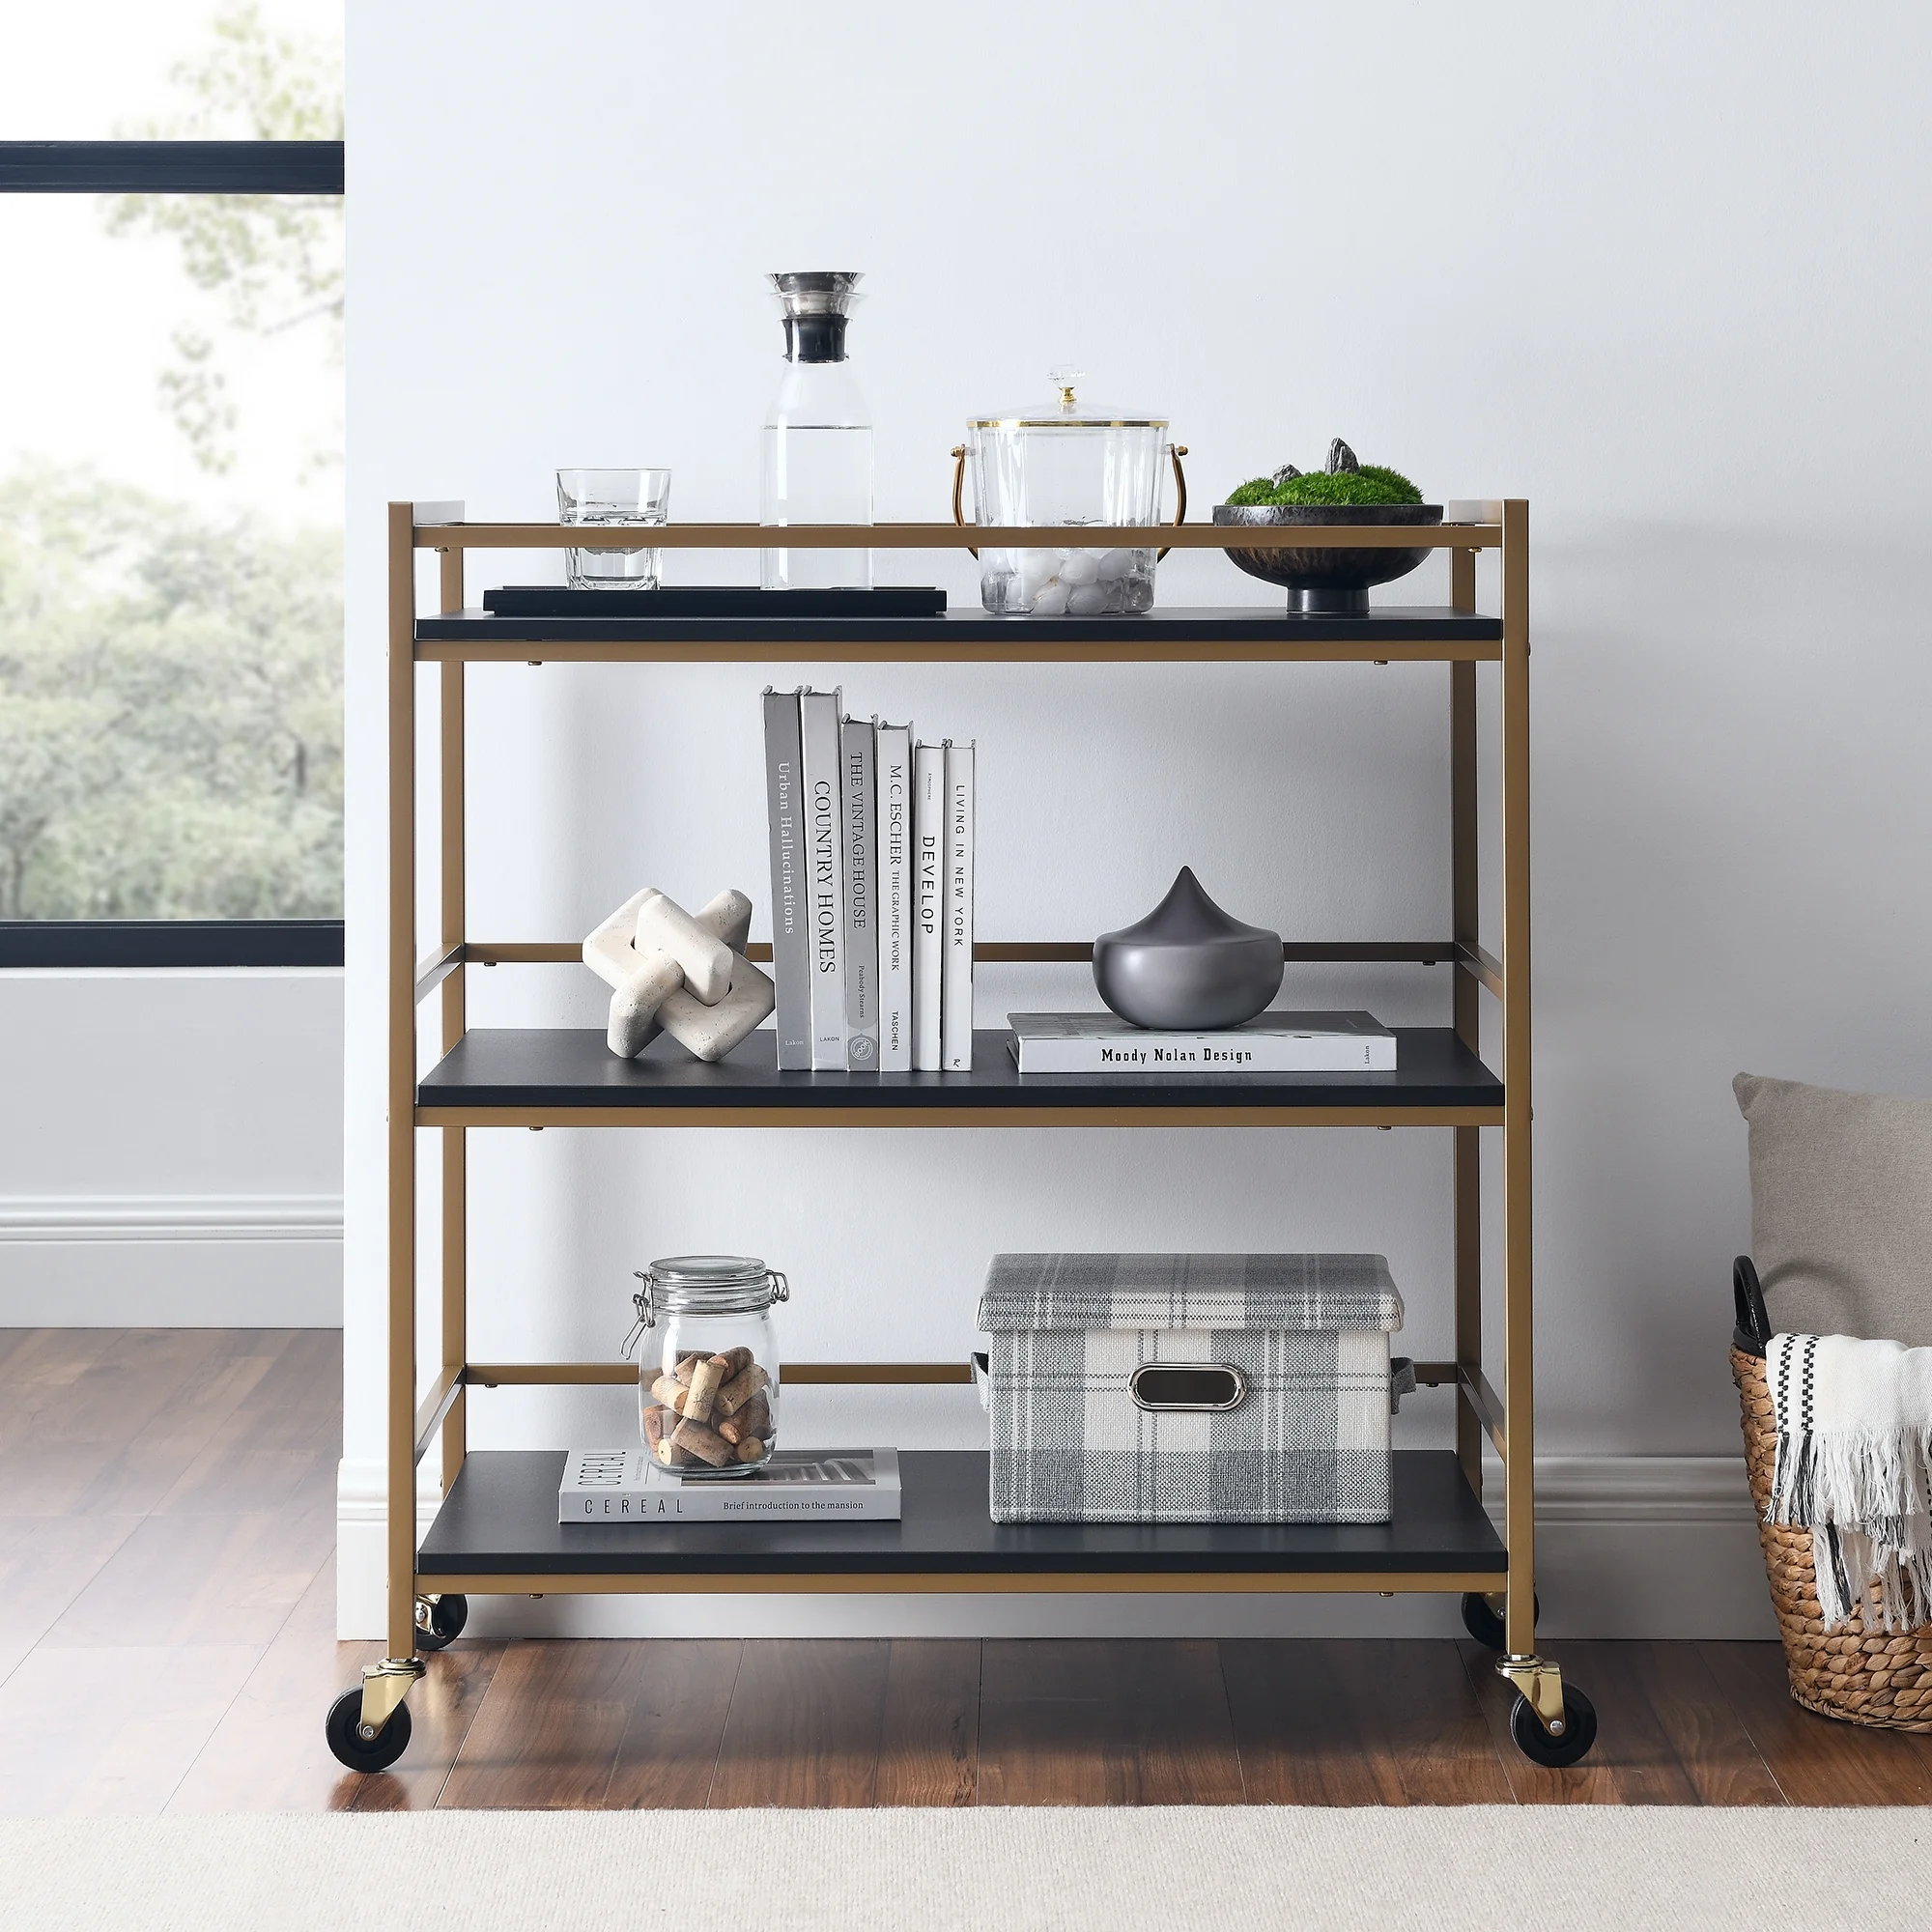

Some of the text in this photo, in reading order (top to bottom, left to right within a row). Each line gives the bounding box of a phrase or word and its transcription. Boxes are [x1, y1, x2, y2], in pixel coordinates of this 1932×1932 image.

[850, 752, 864, 787] THE
[890, 764, 902, 866] M.C. ESCHER
[778, 762, 796, 934] Urban Hallucinations
[953, 784, 965, 946] LIVING IN NEW YORK
[813, 781, 836, 974] COUNTRY HOMES
[921, 836, 935, 934] DEVELOP
[891, 940, 899, 971] WORK
[891, 1010, 899, 1051] TASCHEN
[854, 1039, 869, 1058] BOOK
[1101, 1047, 1252, 1065] Moody Nolan Design
[578, 1451, 626, 1486] CEREAL
[584, 1498, 683, 1514] CEREAL
[724, 1500, 864, 1510] Brief introduction to the mansion
